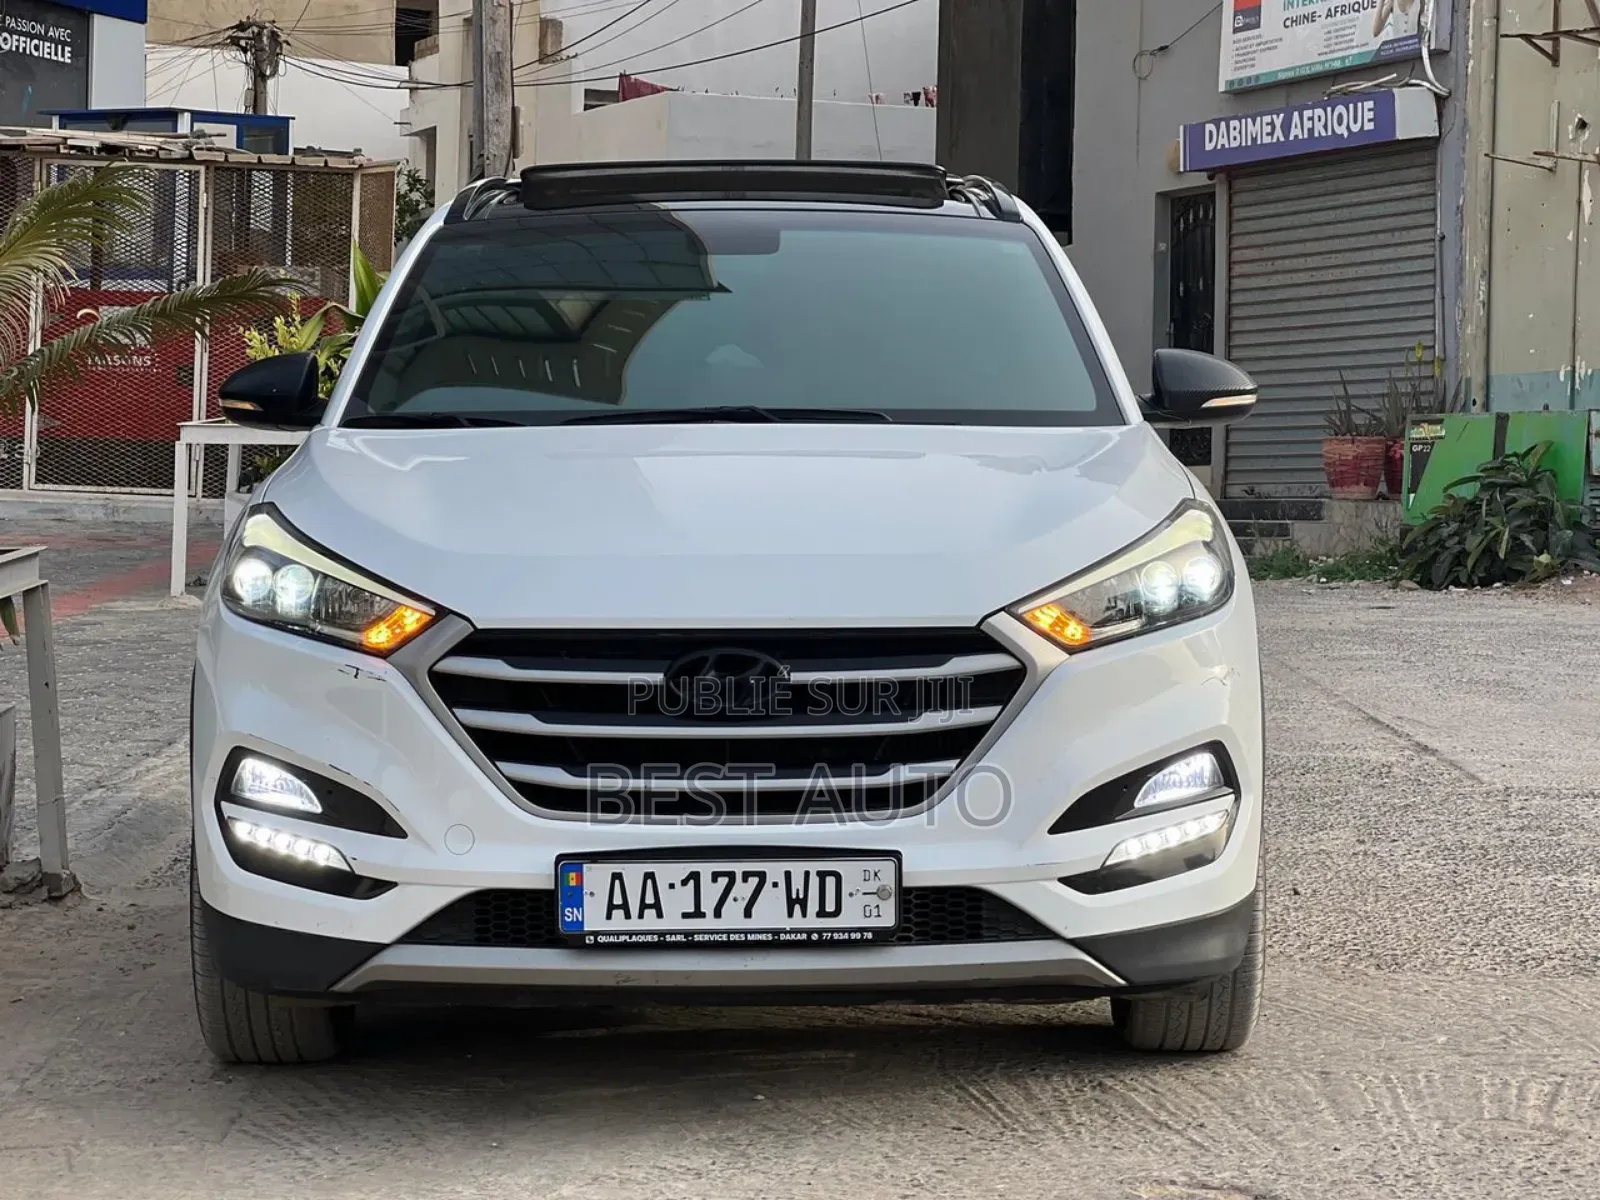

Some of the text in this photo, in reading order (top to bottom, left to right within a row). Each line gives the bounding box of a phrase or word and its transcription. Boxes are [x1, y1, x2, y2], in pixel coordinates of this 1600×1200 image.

[1283, 11, 1322, 29] CHINE-
[1324, 0, 1377, 20] AFRIQUE
[6, 16, 45, 35] PASSION
[47, 27, 72, 42] AVEC
[1204, 100, 1375, 151] DABIMEX AFRIQUE
[863, 869, 881, 881] DK
[564, 906, 582, 922] SN
[597, 934, 658, 942] QUALIPLAQUES
[694, 933, 727, 941] SERVICE
[729, 933, 745, 941] DES
